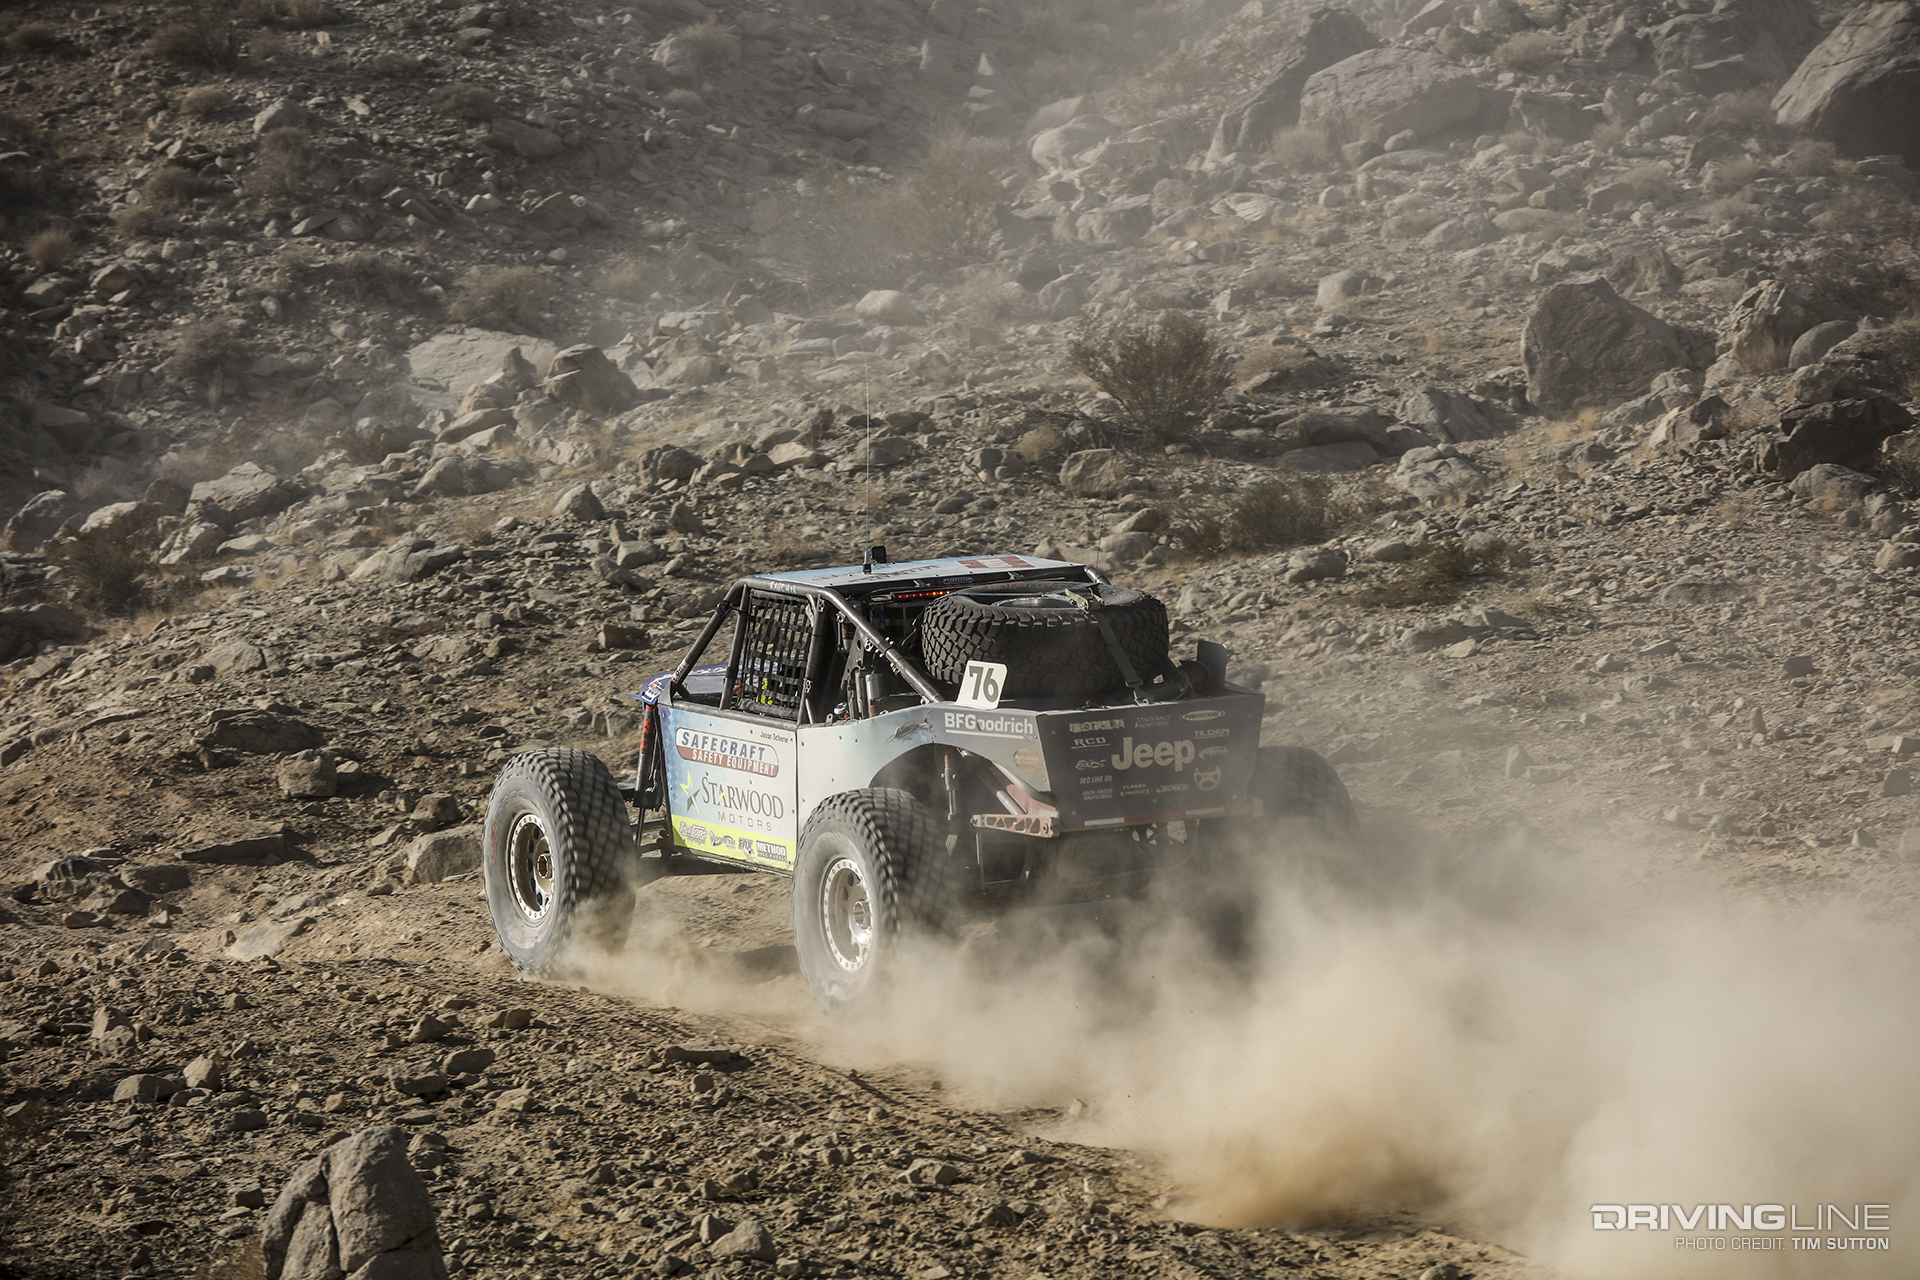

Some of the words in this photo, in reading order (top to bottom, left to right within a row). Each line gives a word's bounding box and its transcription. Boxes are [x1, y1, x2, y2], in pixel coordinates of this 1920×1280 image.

[969, 666, 999, 703] 76
[1073, 736, 1107, 748] RCD
[1194, 727, 1230, 737] TILDEN
[681, 731, 765, 761] SAFECRAFT
[1111, 736, 1196, 772] Jeep
[692, 749, 724, 766] SAFETY
[726, 755, 776, 776] EQUIPMENT
[1091, 775, 1104, 784] LINE
[701, 776, 784, 820] STARWOOD
[717, 811, 773, 832] MOTORS
[756, 841, 787, 856] METHOD
